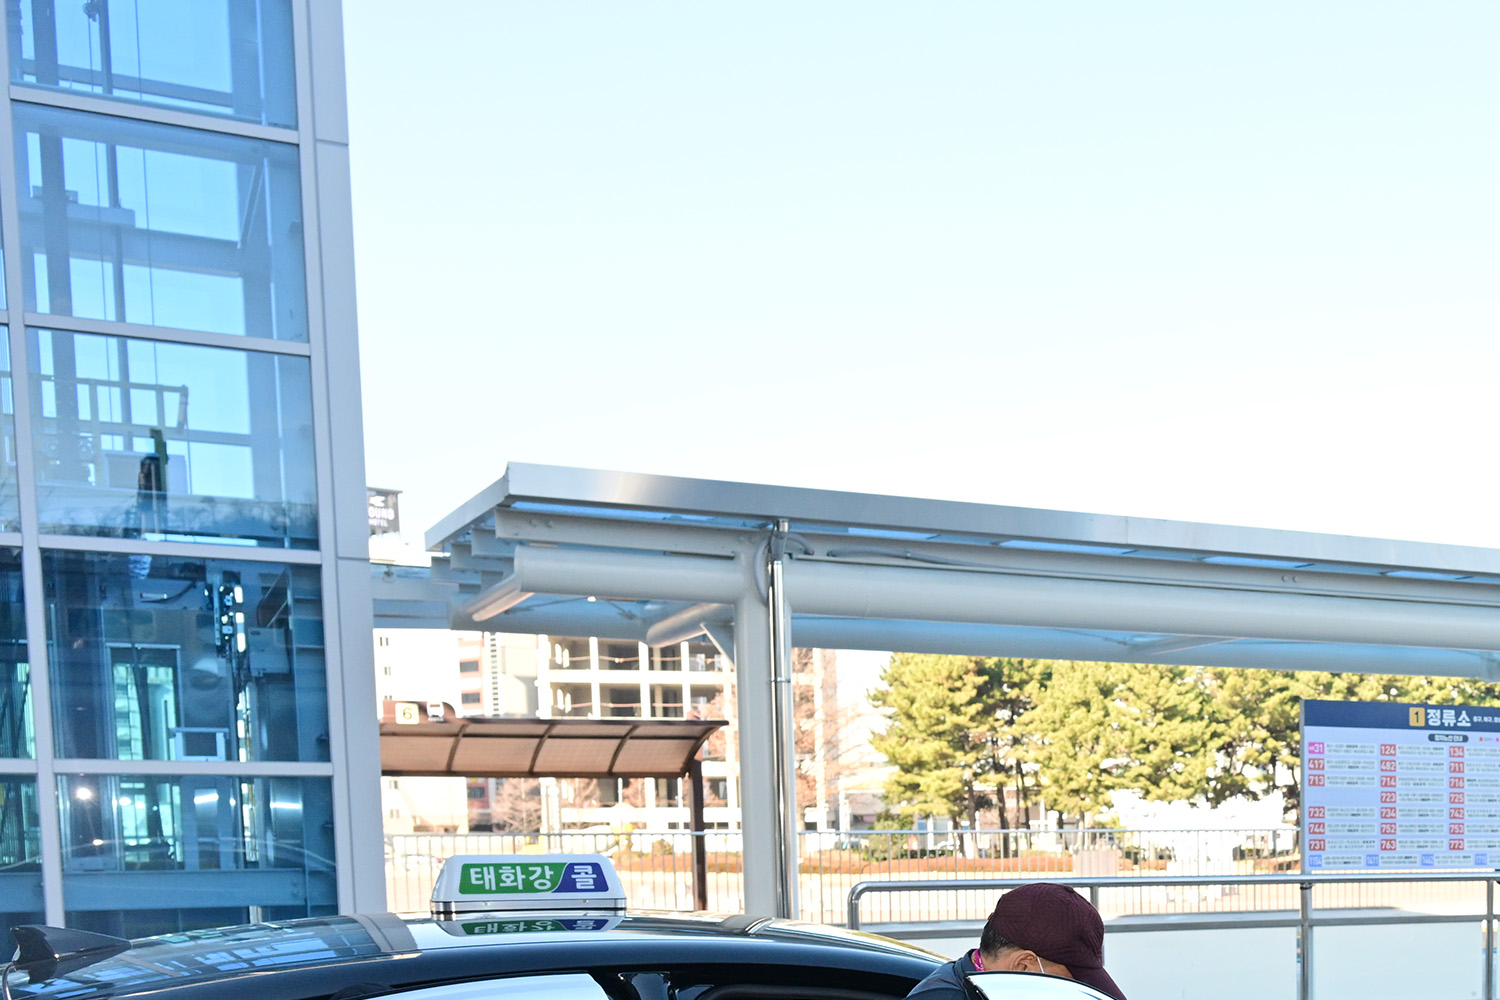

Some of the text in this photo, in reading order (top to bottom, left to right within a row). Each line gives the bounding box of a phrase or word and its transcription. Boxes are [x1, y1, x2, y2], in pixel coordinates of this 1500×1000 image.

[402, 706, 413, 720] 6
[1427, 708, 1471, 727] 정류소
[1450, 762, 1464, 772] 711
[1309, 775, 1324, 785] 713
[1381, 776, 1396, 786] 714
[1381, 792, 1396, 802] 723
[1309, 807, 1324, 817] 732
[1381, 808, 1396, 818] 734
[1381, 824, 1396, 833] 752
[1310, 840, 1324, 850] 731
[1381, 840, 1396, 849] 763
[1450, 840, 1464, 849] 773
[469, 865, 597, 891] 태화강 콜
